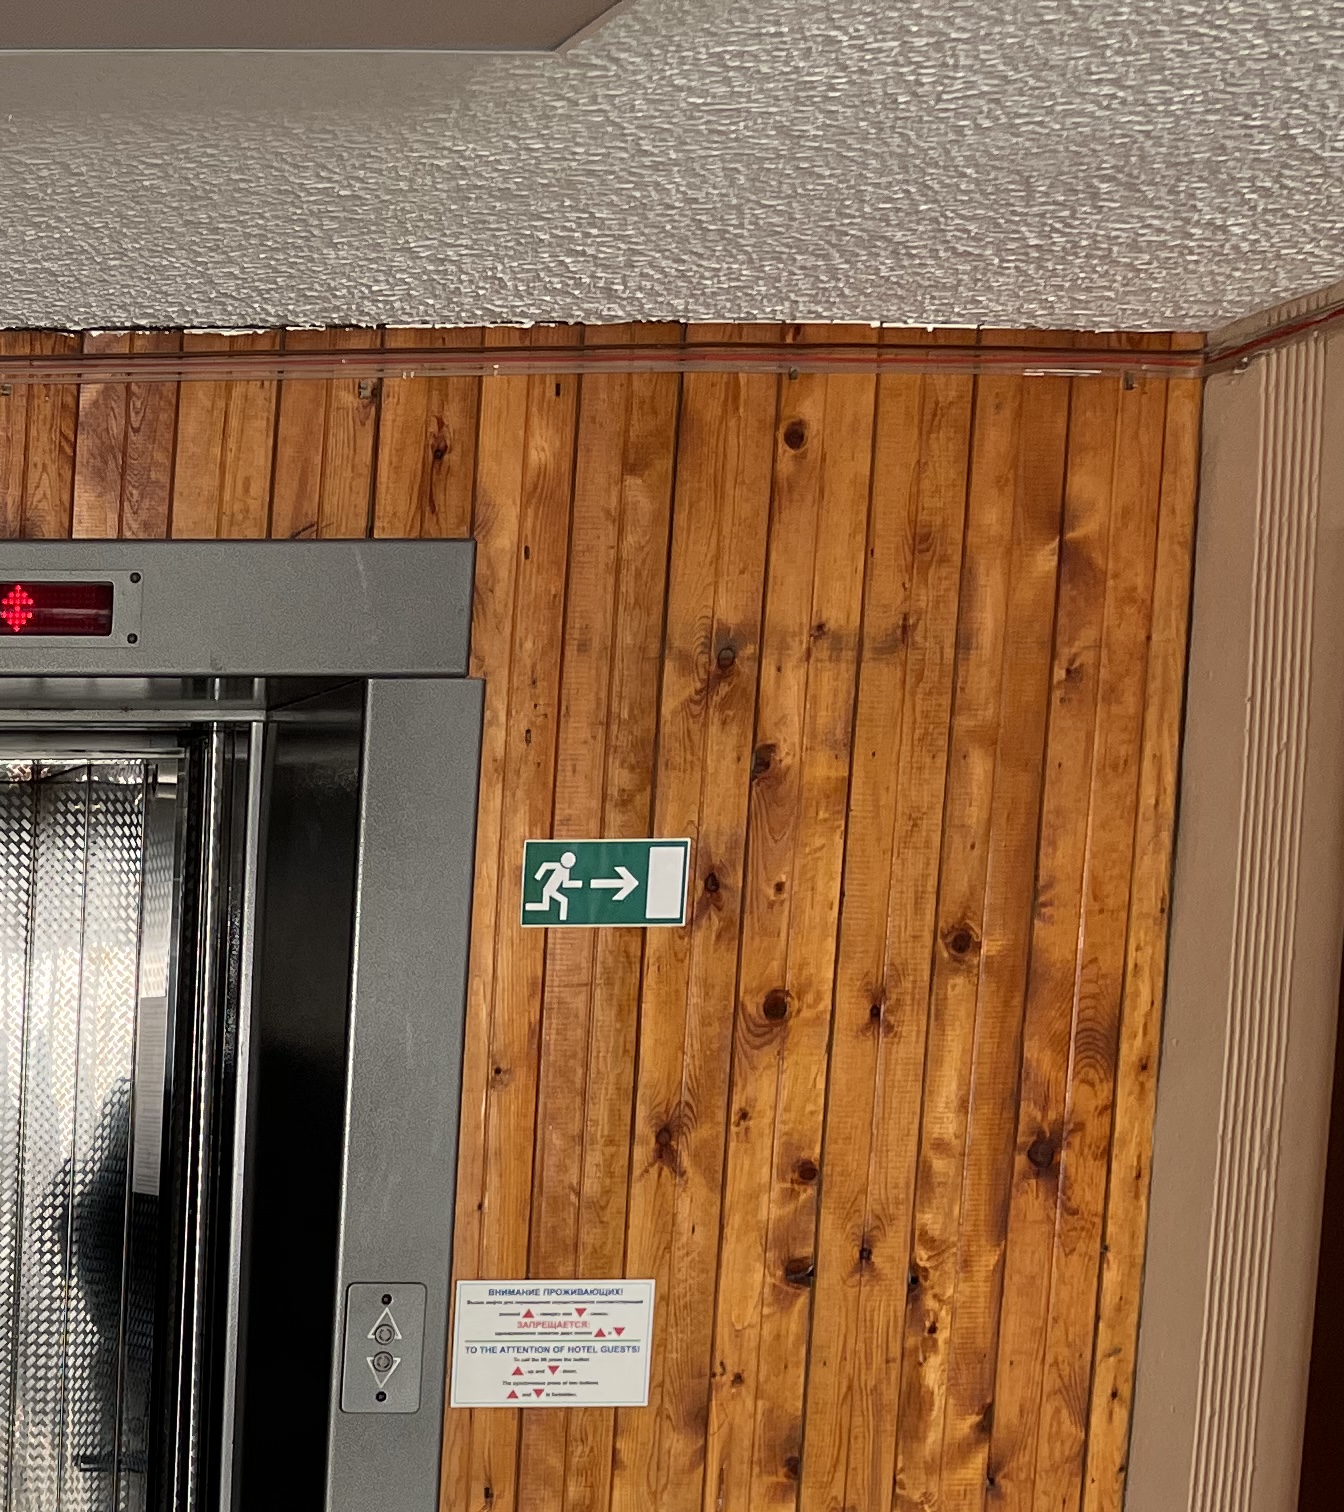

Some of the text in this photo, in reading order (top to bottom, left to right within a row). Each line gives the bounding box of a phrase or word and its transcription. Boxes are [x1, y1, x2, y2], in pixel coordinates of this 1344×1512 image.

[488, 1287, 624, 1298] ВНИМАНИЕ ПРОЖИВАЮЩИХ!
[516, 1320, 591, 1330] ЗАПРЕЩАЕТСЯ:
[465, 1344, 640, 1354] TO THE ATTENTION OF HOTEL GUESTS!
